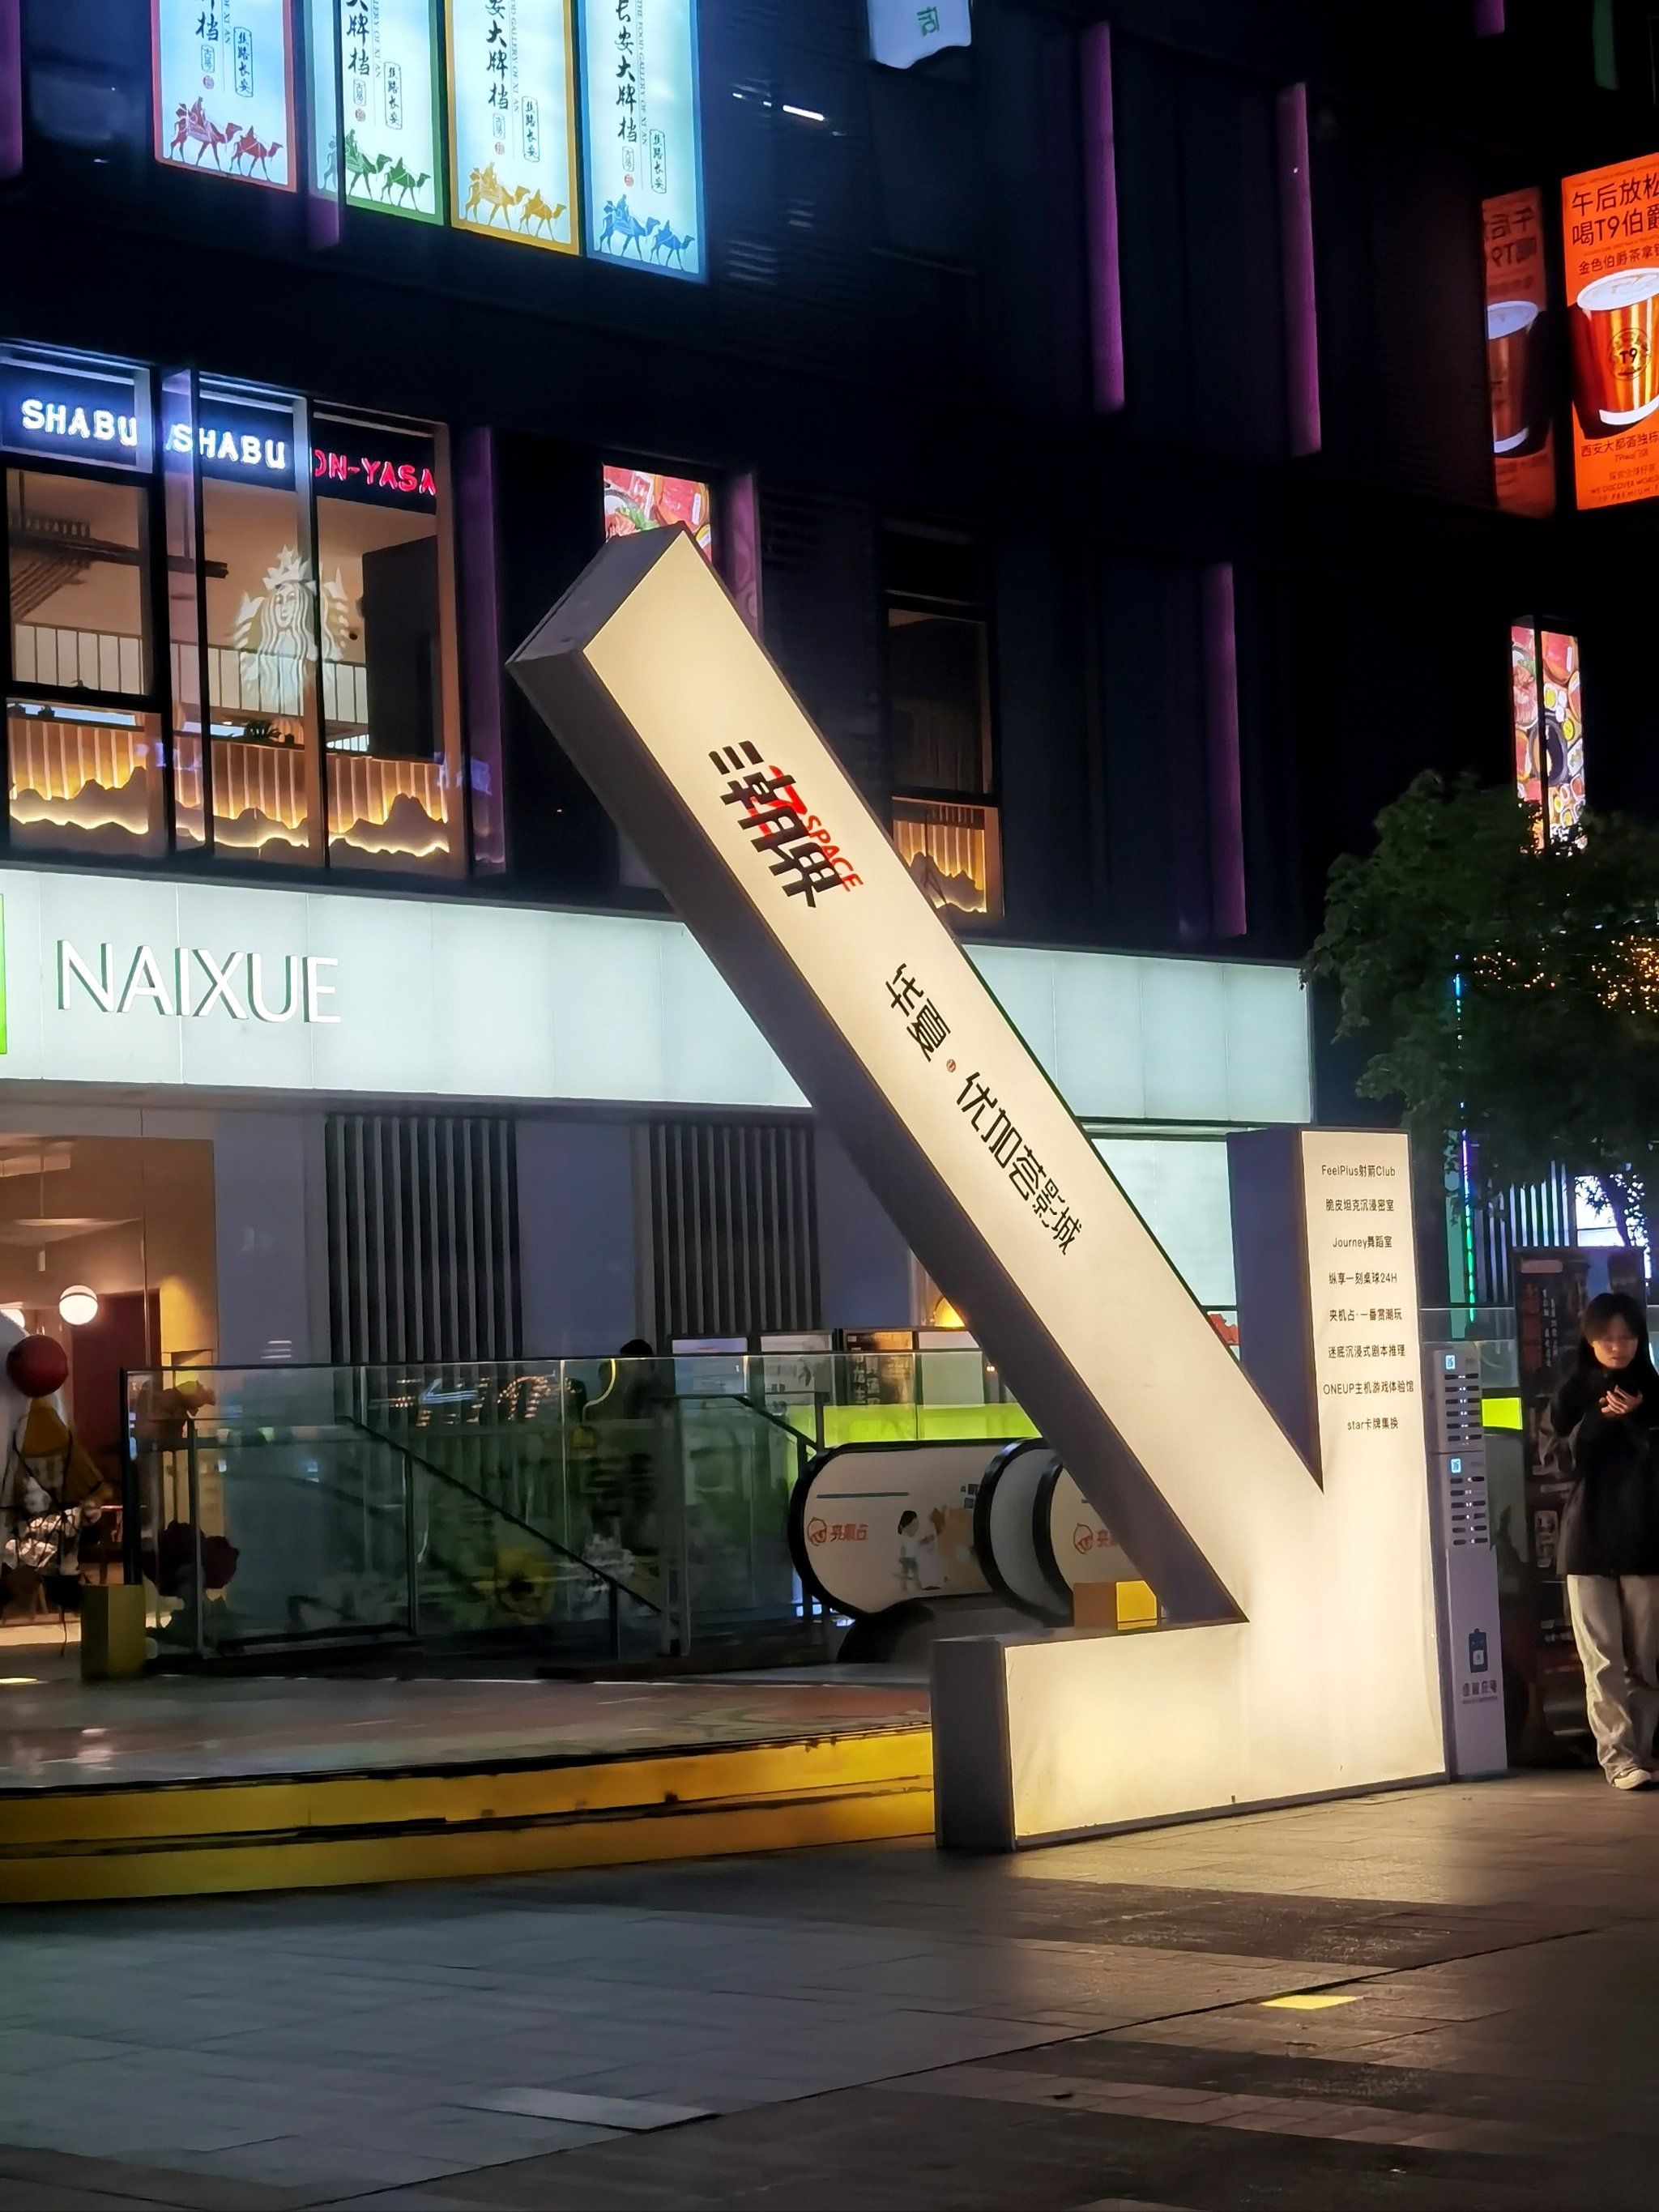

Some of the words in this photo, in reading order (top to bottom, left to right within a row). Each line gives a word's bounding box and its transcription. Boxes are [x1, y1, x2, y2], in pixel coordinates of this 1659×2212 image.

[195, 0, 219, 41] 档
[615, 0, 638, 143] 长安大牌档
[1572, 173, 1659, 217] 午后放松
[1572, 202, 1659, 246] 喝T9伯爵
[1619, 347, 1638, 364] T9
[22, 399, 138, 446] SHABU
[172, 423, 286, 469] SHABU
[708, 740, 844, 908] 潮界
[807, 815, 864, 893] SPACE
[57, 940, 342, 1024] NAIXUE
[885, 962, 952, 1063] 华夏
[955, 1070, 1084, 1256] 优加荟影城
[1321, 1164, 1396, 1178] FeelPlus射箭Club
[1325, 1199, 1395, 1212] 脆皮坦克沉浸密室
[1333, 1235, 1392, 1250] Journey舞蹈室
[1328, 1272, 1397, 1285] 纵享一刻桌球24H
[1323, 1380, 1414, 1395] ONEUP主机游戏体验馆
